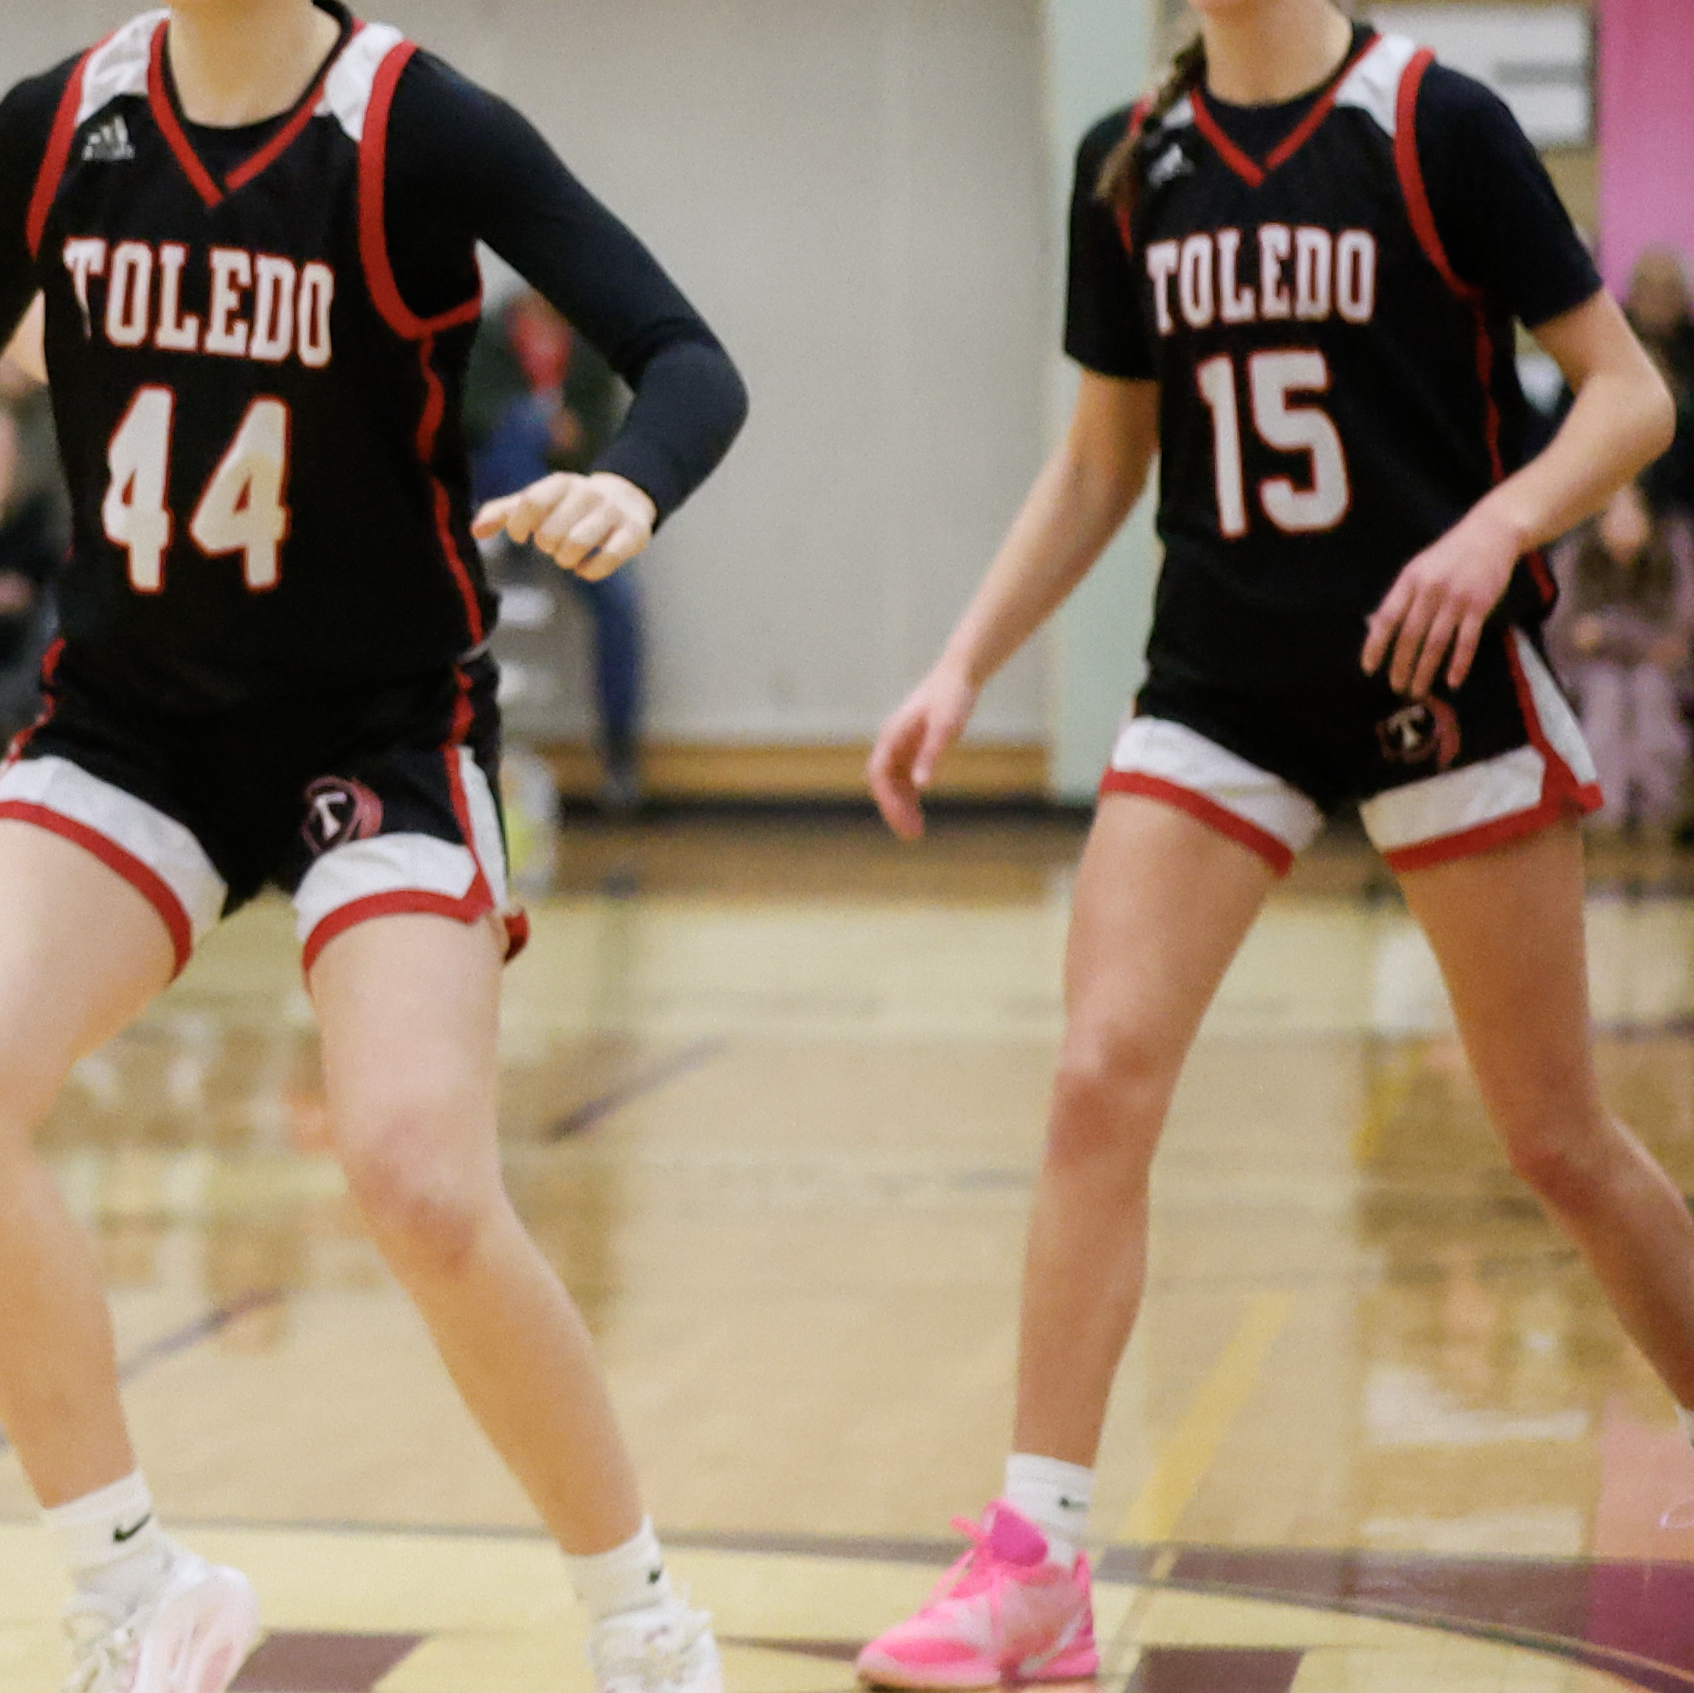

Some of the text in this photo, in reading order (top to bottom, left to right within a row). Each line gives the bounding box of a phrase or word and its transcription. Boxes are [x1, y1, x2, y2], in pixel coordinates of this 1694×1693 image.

[61, 235, 336, 369] TOLEDO
[1145, 223, 1377, 337] TOLEDO
[101, 382, 292, 594] 44
[1196, 348, 1351, 540] 15
